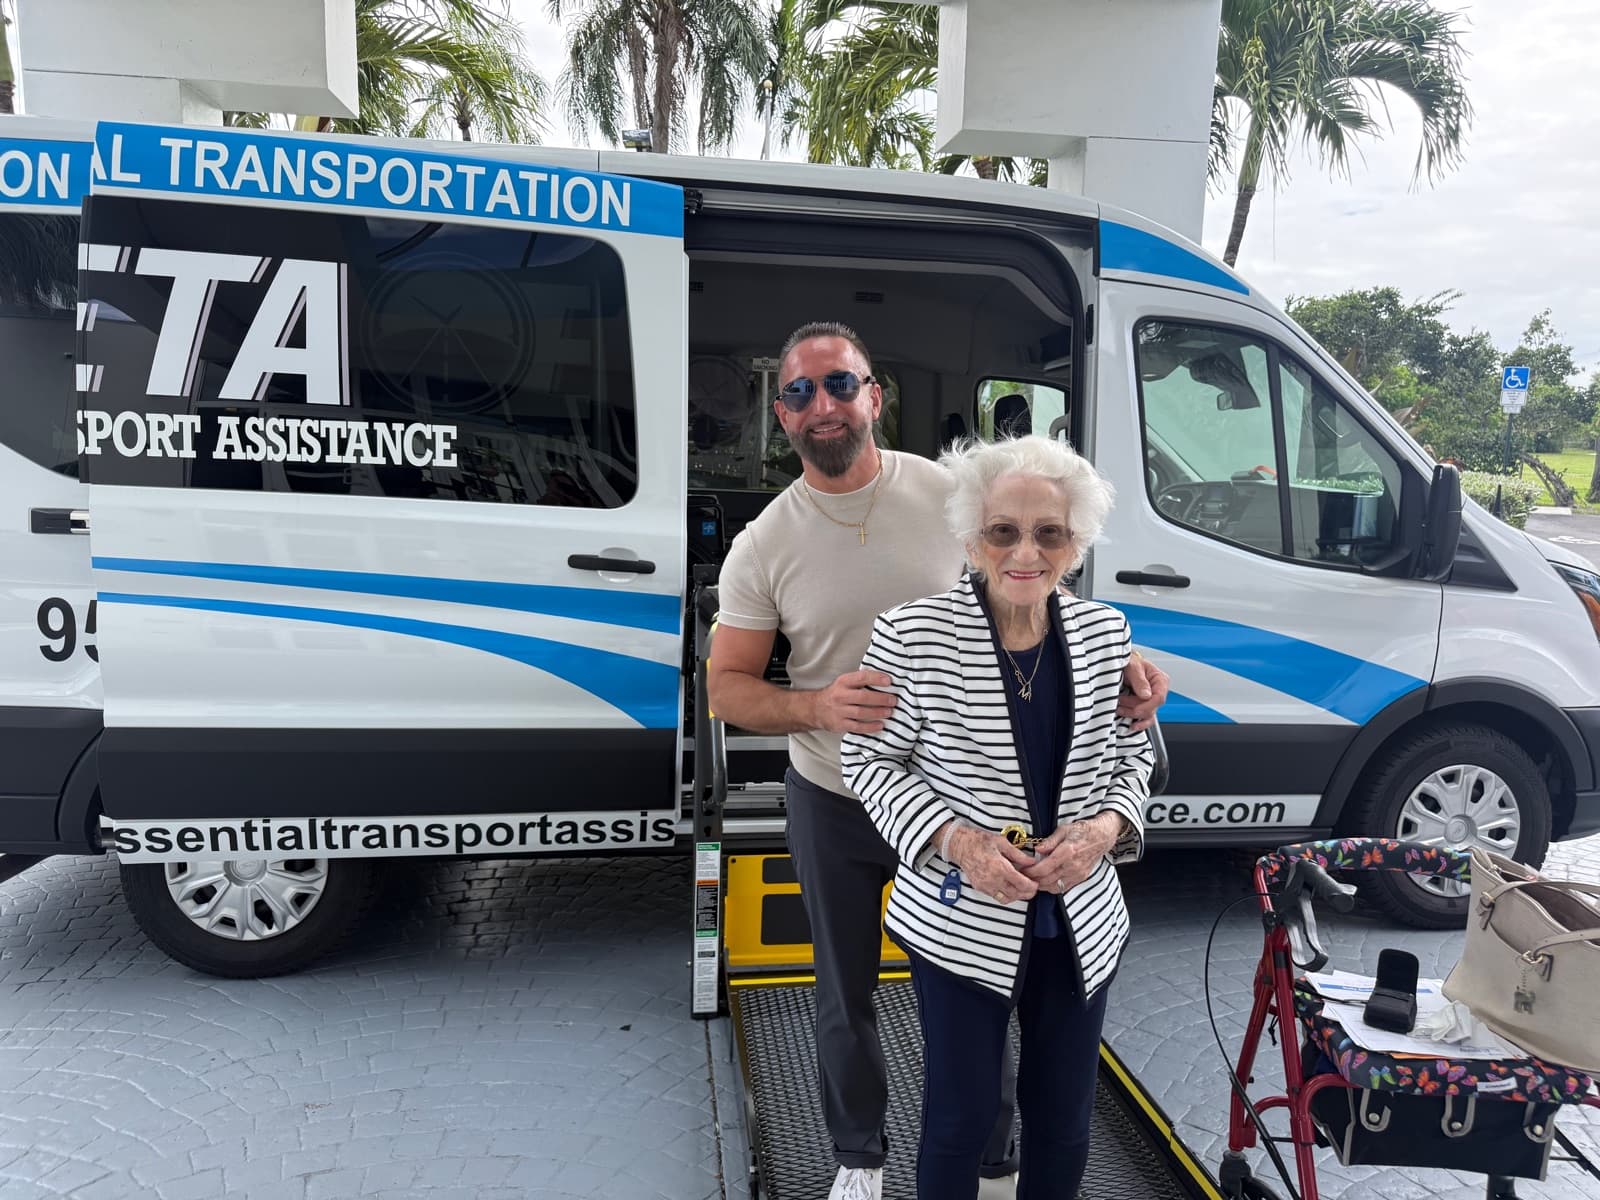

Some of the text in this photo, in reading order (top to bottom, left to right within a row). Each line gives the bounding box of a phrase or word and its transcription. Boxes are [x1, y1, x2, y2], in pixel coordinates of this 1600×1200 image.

[0, 150, 70, 199] ON
[160, 137, 631, 227] TRANSPORTATION
[212, 416, 458, 467] ASSISTANCE
[1145, 802, 1286, 824] ce.com
